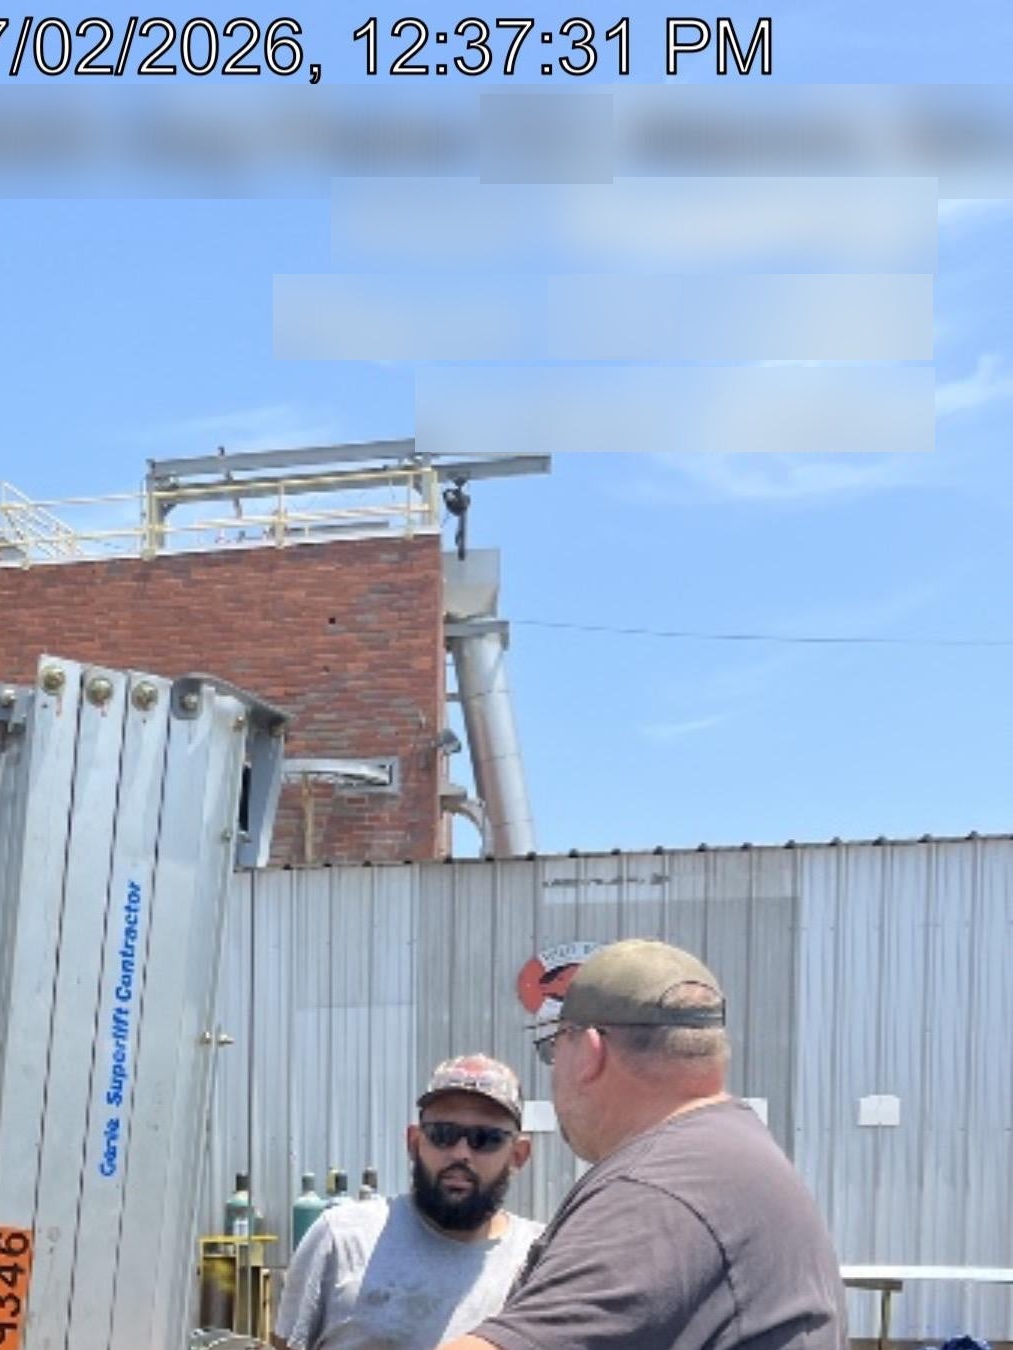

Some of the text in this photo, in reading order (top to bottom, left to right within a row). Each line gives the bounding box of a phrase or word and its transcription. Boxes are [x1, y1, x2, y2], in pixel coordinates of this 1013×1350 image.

[98, 880, 141, 1178] Genie Superlift Contractor
